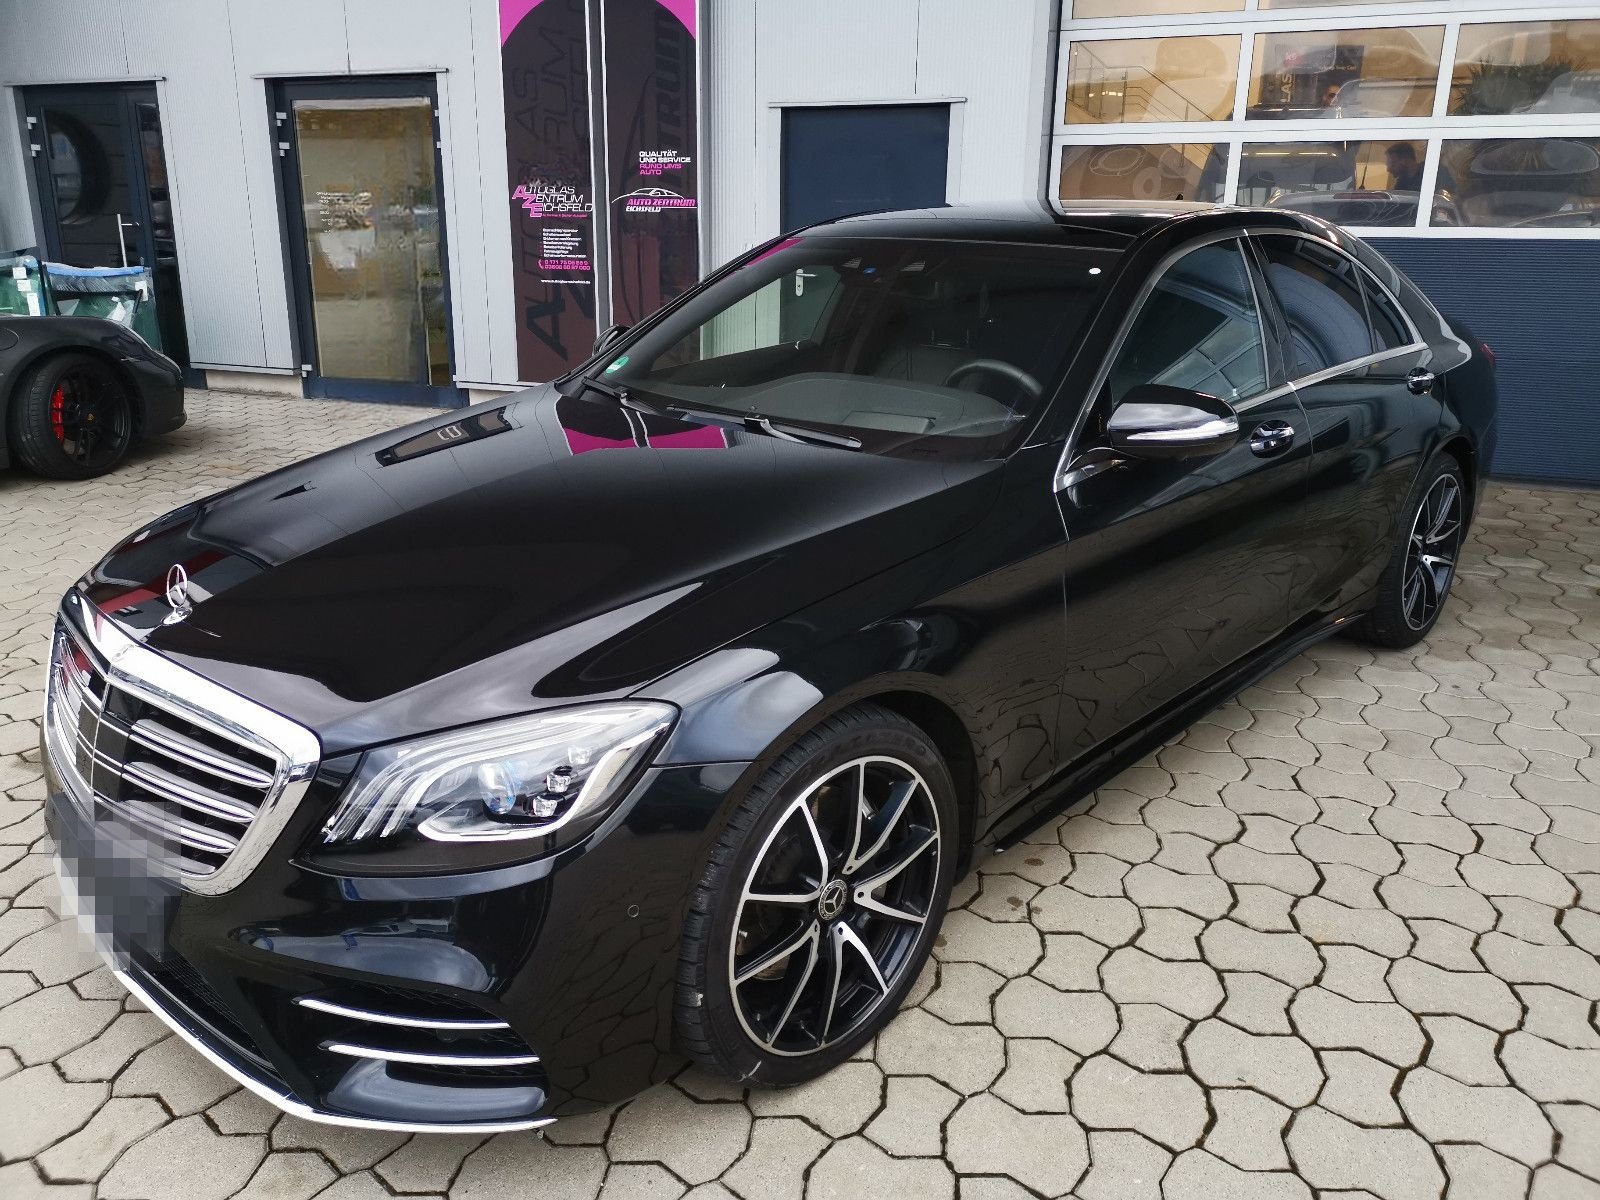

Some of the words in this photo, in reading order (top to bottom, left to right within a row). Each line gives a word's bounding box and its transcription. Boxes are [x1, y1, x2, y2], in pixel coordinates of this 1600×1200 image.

[639, 149, 677, 157] QUALITÄT
[511, 185, 575, 199] AUTOGLAS
[522, 193, 584, 209] ZENTRUM
[627, 198, 652, 206] AUTO
[652, 198, 696, 207] ZENTRUM
[530, 202, 593, 217] EICHSFELD
[625, 205, 661, 213] EICHSFELD
